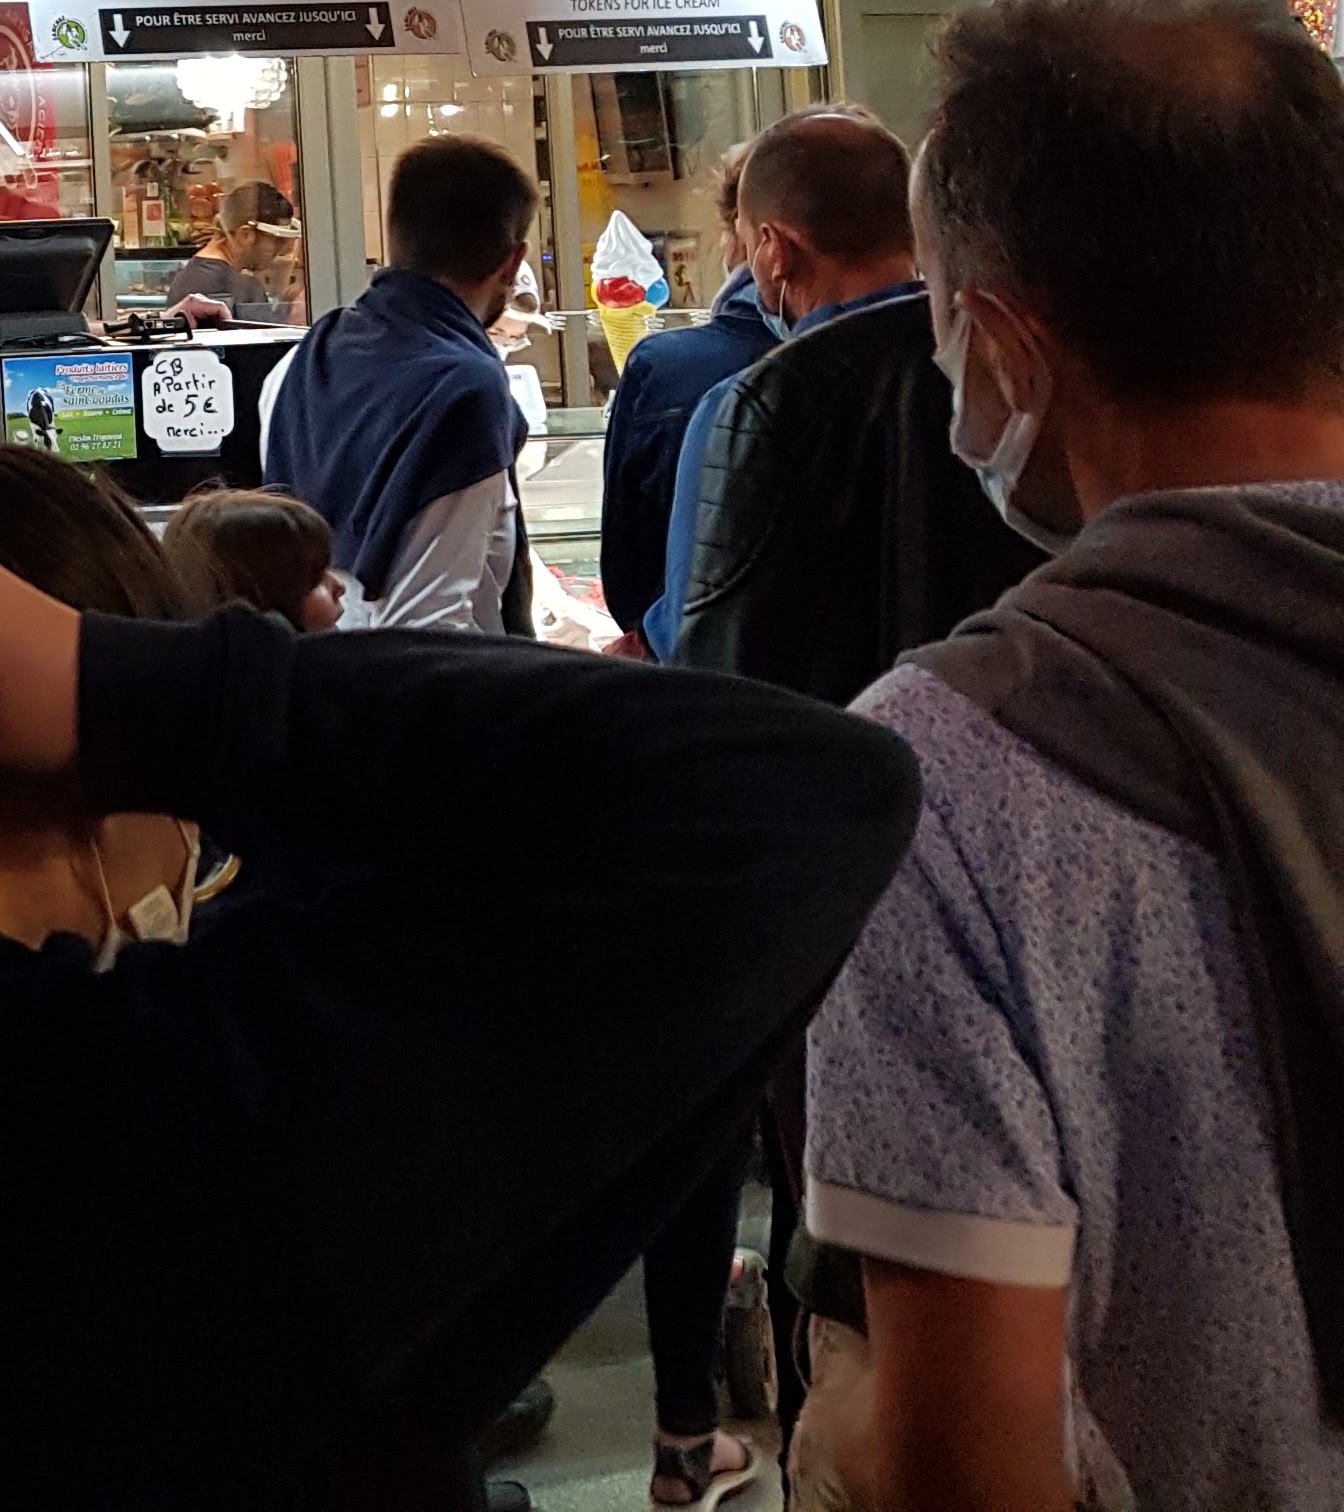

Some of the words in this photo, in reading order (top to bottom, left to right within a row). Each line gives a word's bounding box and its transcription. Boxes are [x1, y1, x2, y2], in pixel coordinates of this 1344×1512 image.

[135, 15, 171, 27] POUR
[173, 11, 203, 25] ÊTRE
[205, 13, 240, 25] SERVI
[242, 12, 296, 24] AVANCEZ
[232, 30, 267, 42] merci
[558, 26, 588, 39] POUR
[616, 26, 645, 37] SERVI
[646, 24, 691, 36] AVANCEZ
[155, 358, 183, 376] CB
[153, 382, 161, 397] A
[162, 373, 216, 392] Partir
[155, 398, 174, 414] de
[183, 394, 199, 418] 5
[203, 396, 218, 414] €
